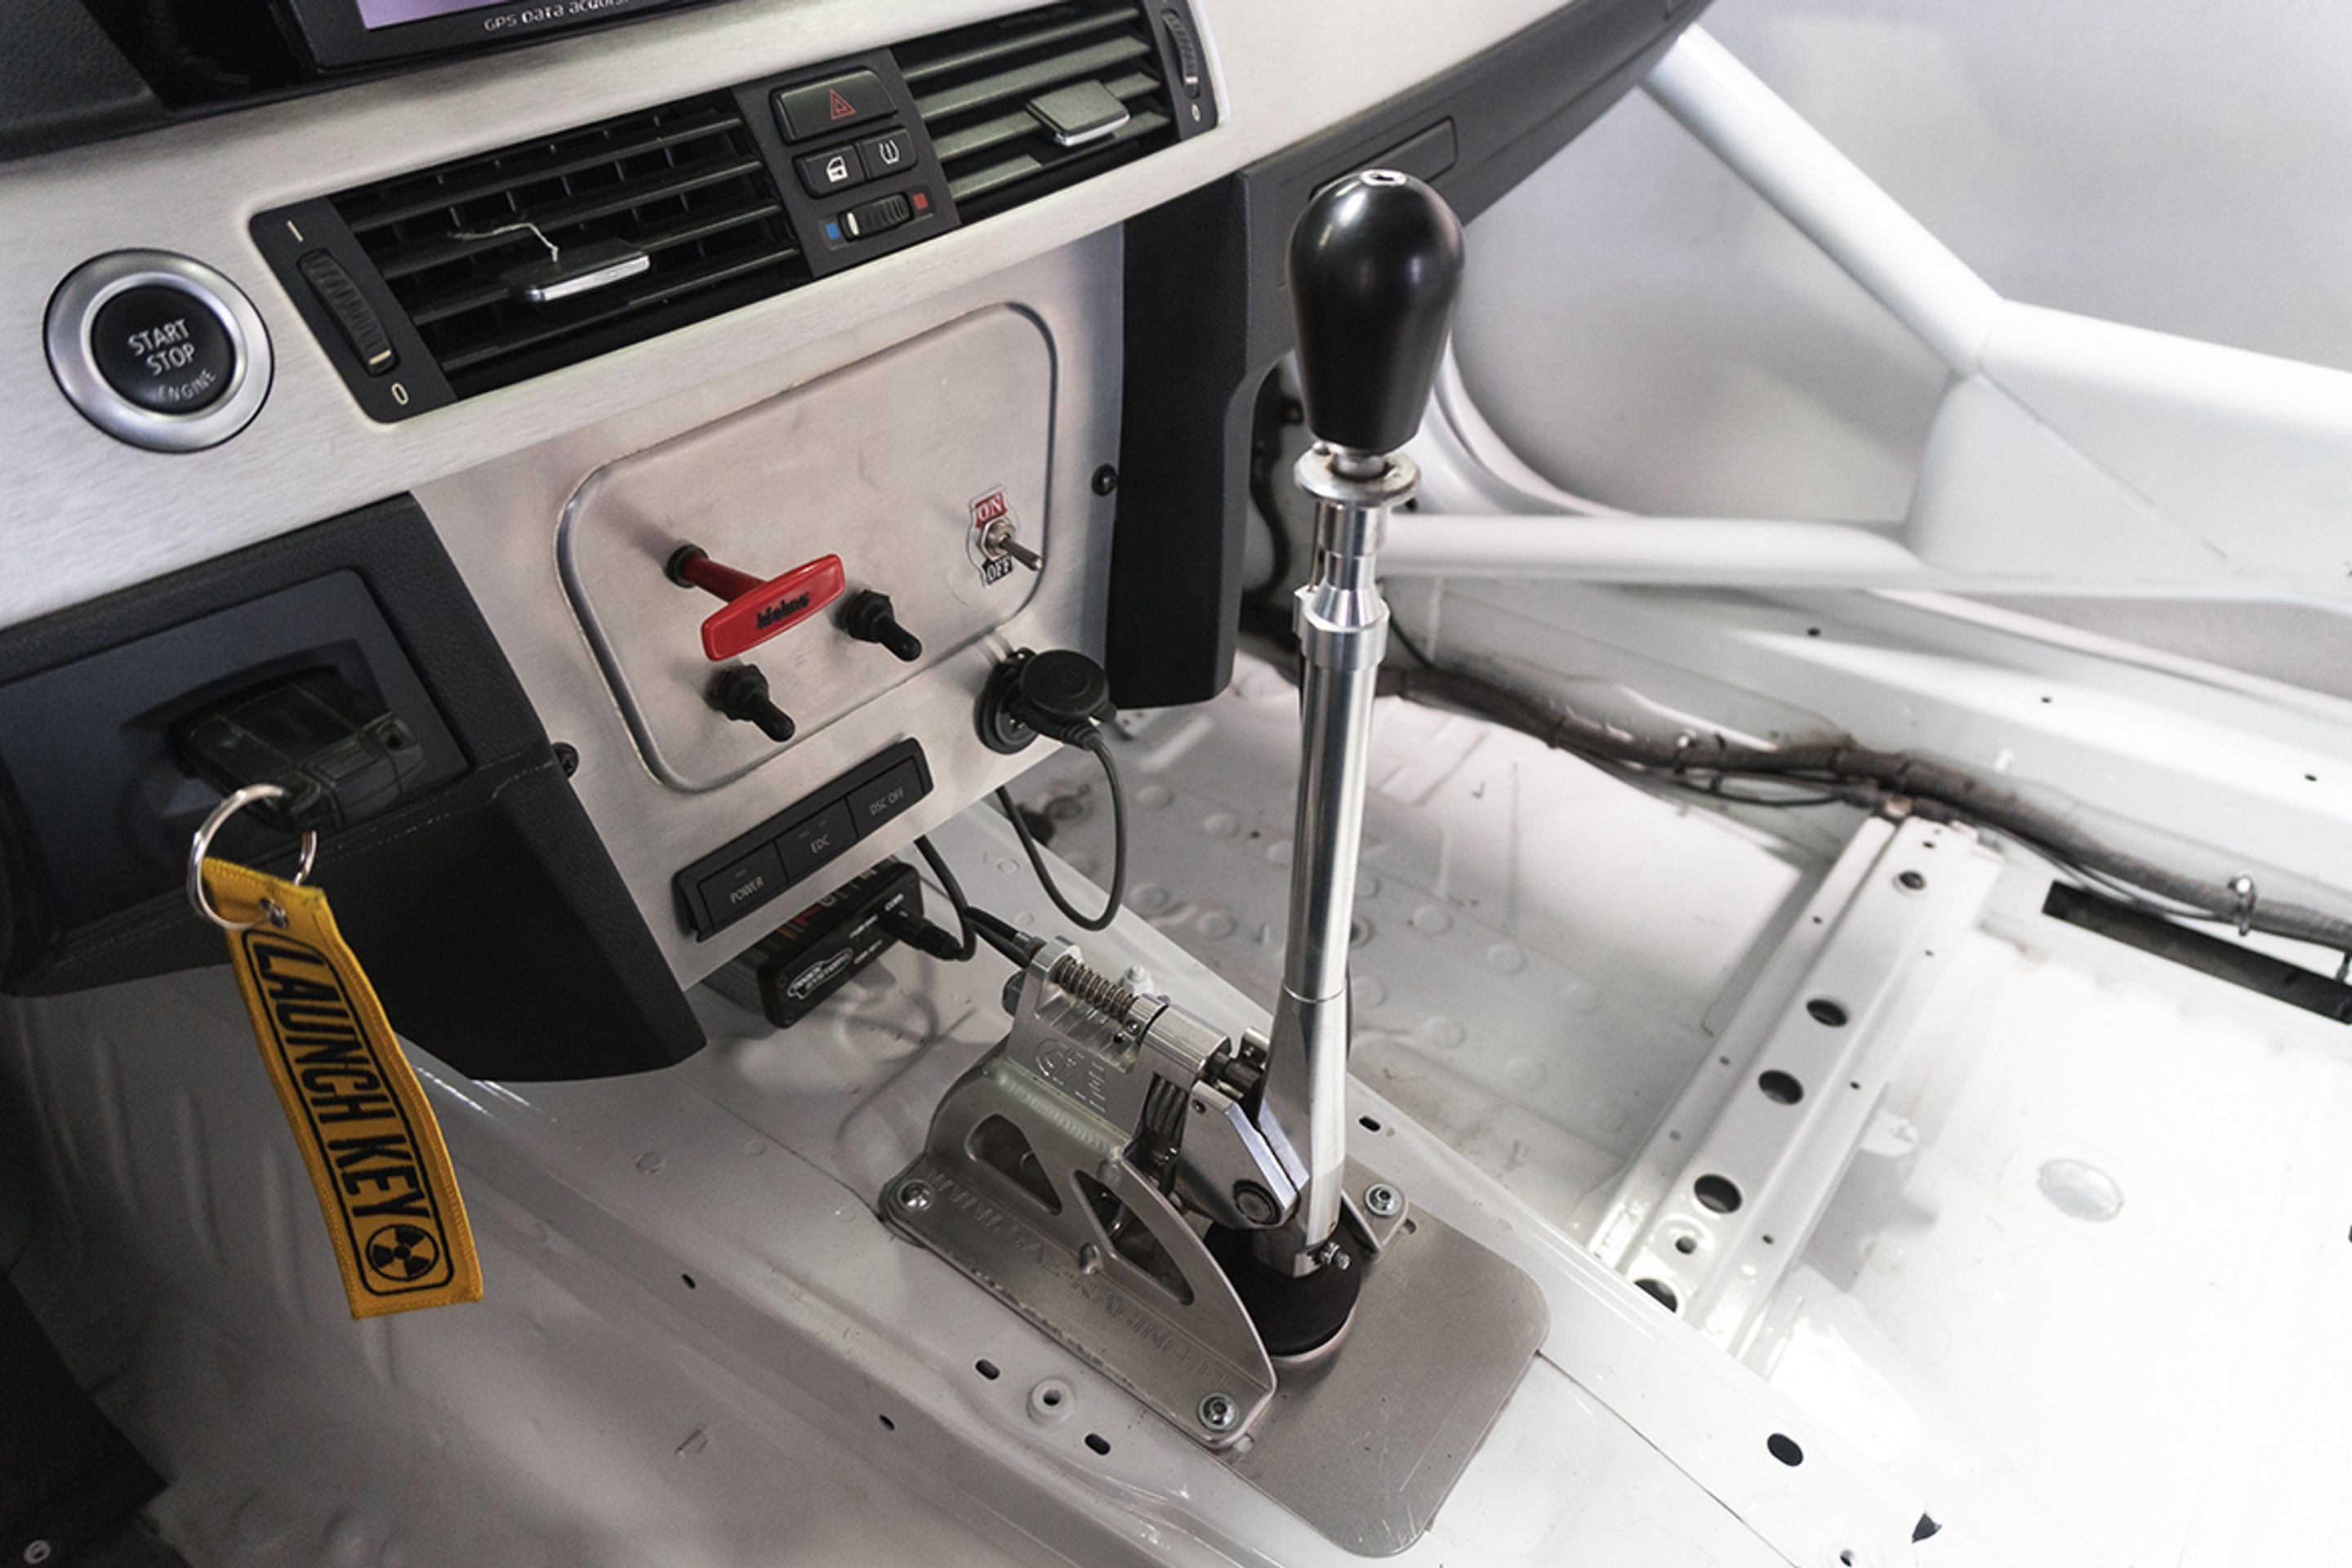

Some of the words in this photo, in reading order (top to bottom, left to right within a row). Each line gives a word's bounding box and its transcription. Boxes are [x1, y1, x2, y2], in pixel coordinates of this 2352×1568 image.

[484, 14, 518, 31] GPS
[128, 318, 189, 356] START
[145, 342, 195, 376] STOP
[158, 368, 216, 402] ENGINE
[979, 492, 1004, 519] ON
[987, 558, 1011, 581] OFF
[869, 796, 887, 816] DSC
[888, 786, 906, 804] OFF
[809, 833, 831, 854] EDC
[729, 875, 765, 904] POWER
[252, 942, 397, 1125] LAUNCH
[327, 1133, 431, 1220] KEY
